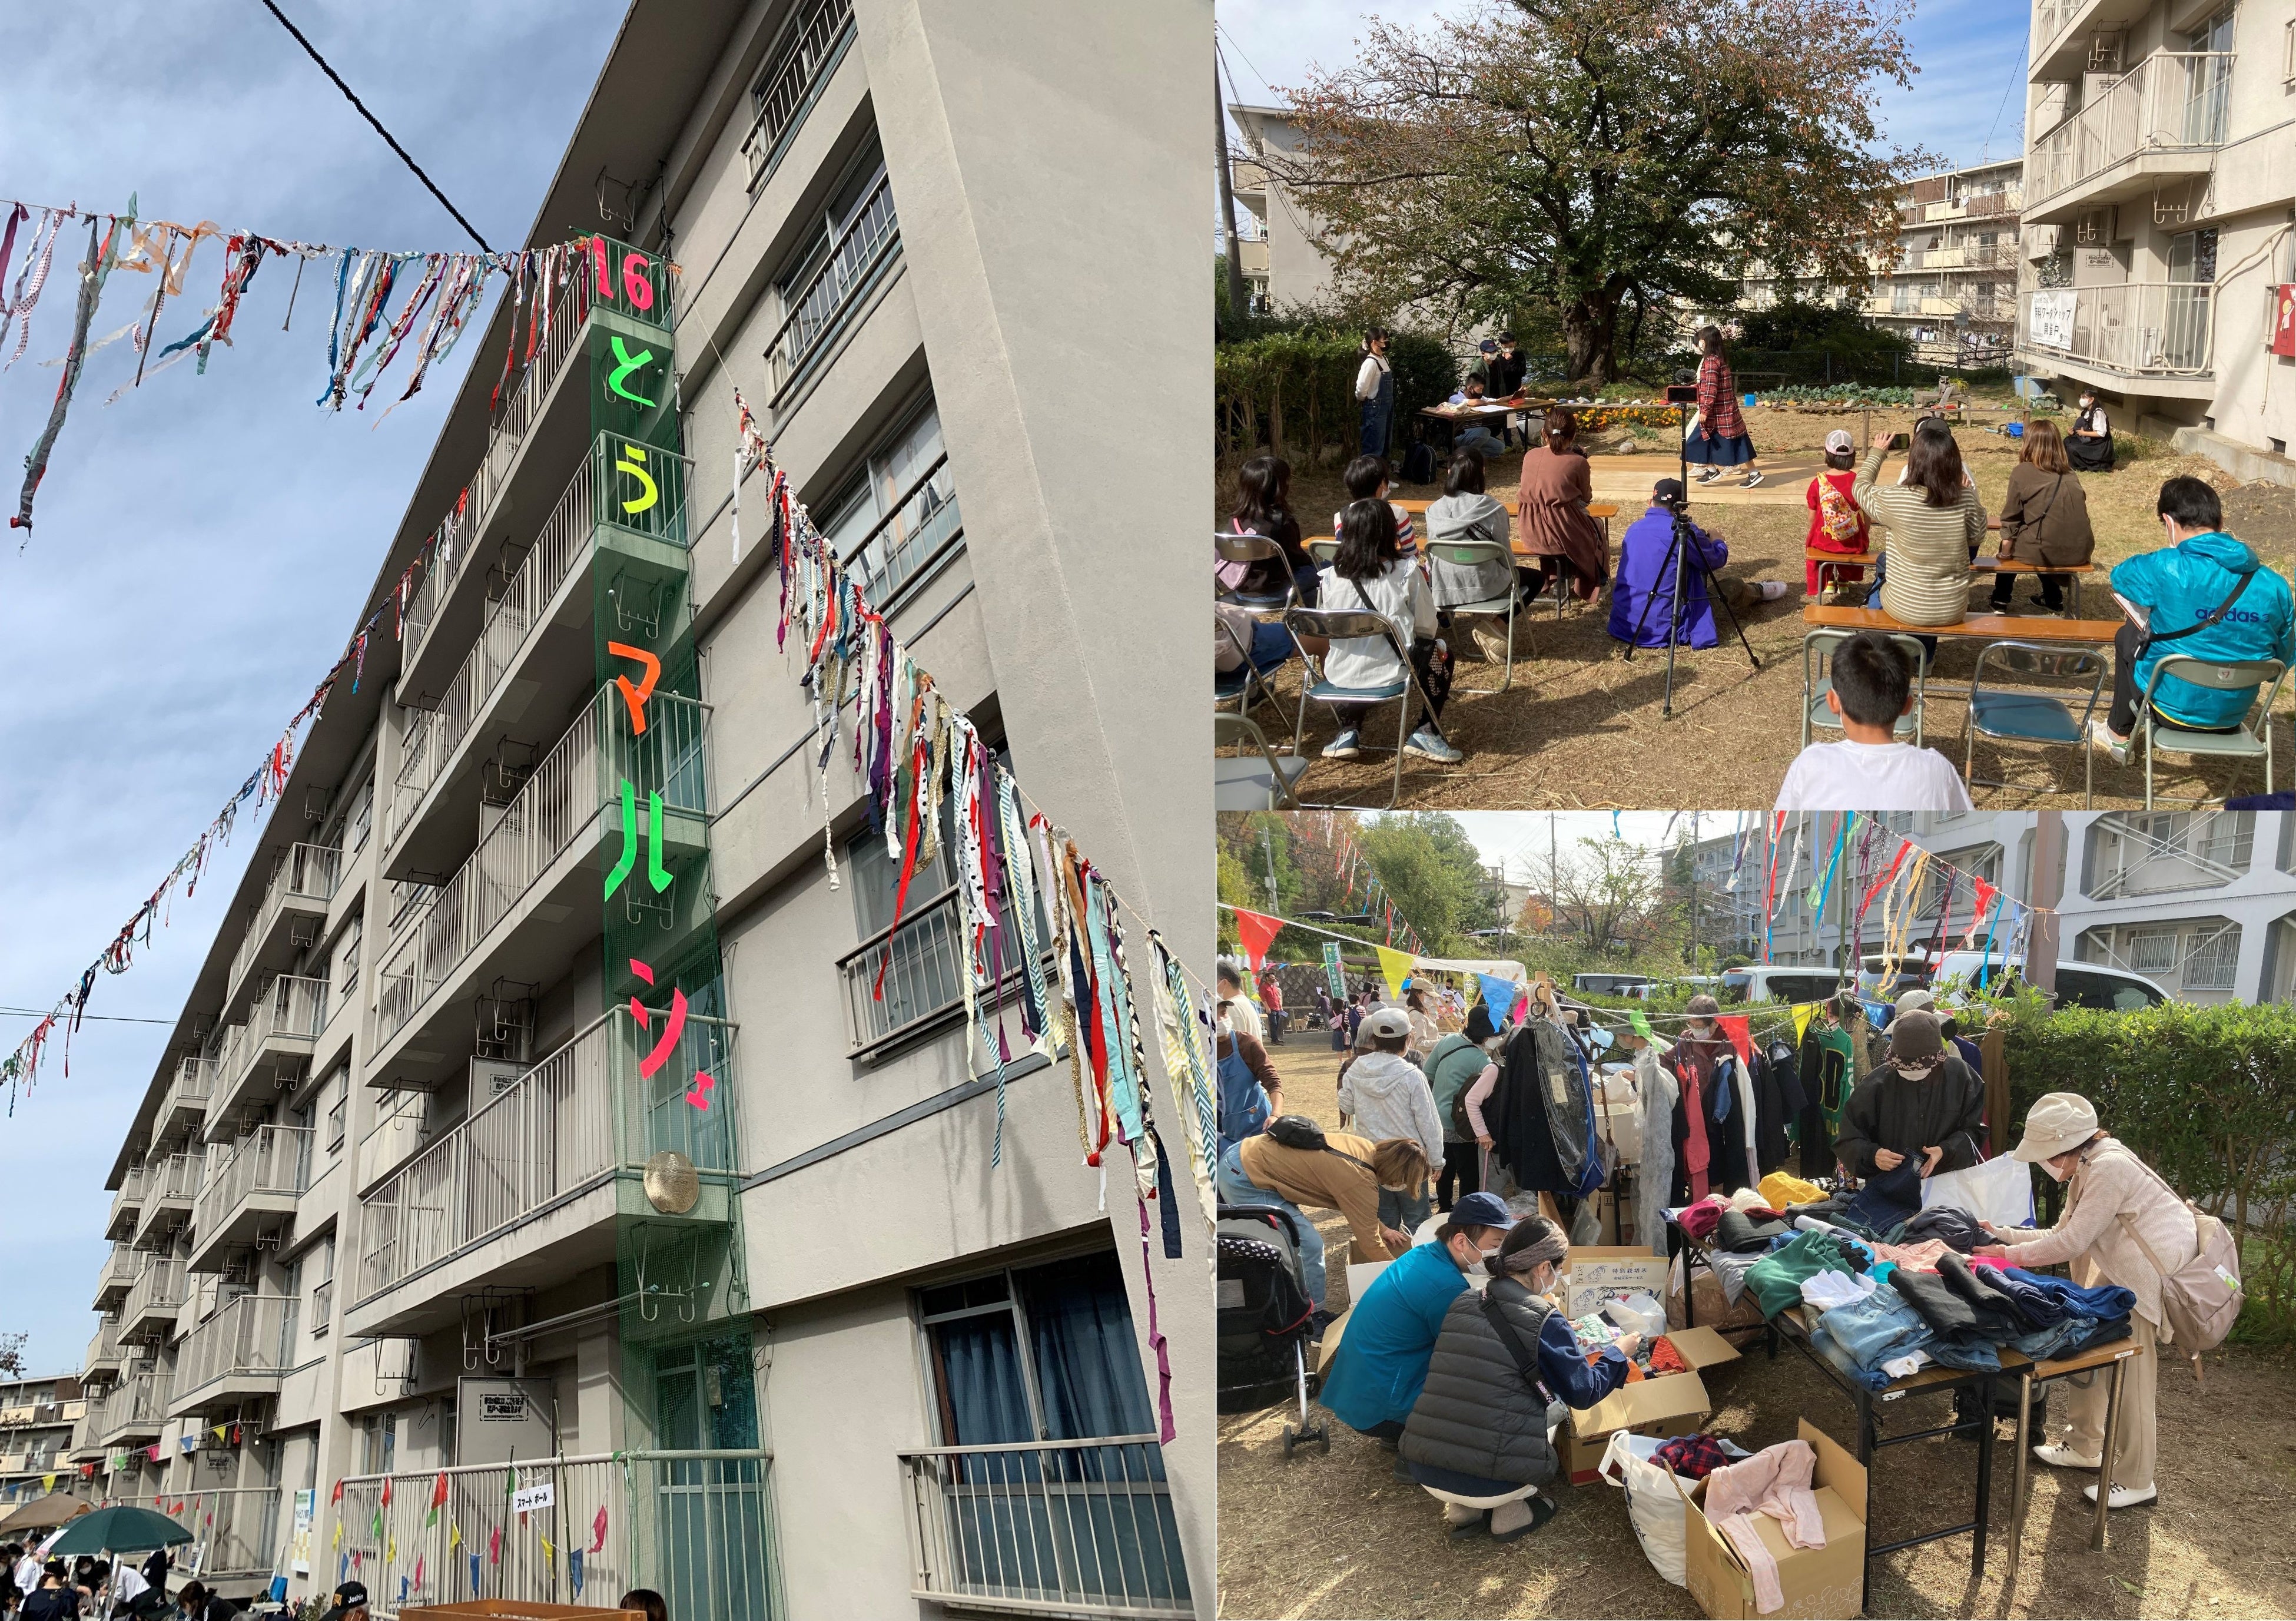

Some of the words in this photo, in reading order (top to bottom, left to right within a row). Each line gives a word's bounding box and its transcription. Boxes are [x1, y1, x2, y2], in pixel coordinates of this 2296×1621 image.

[517, 1496, 532, 1508] スマート
[535, 1492, 547, 1504] ボール
[348, 1593, 364, 1603] Joshin
